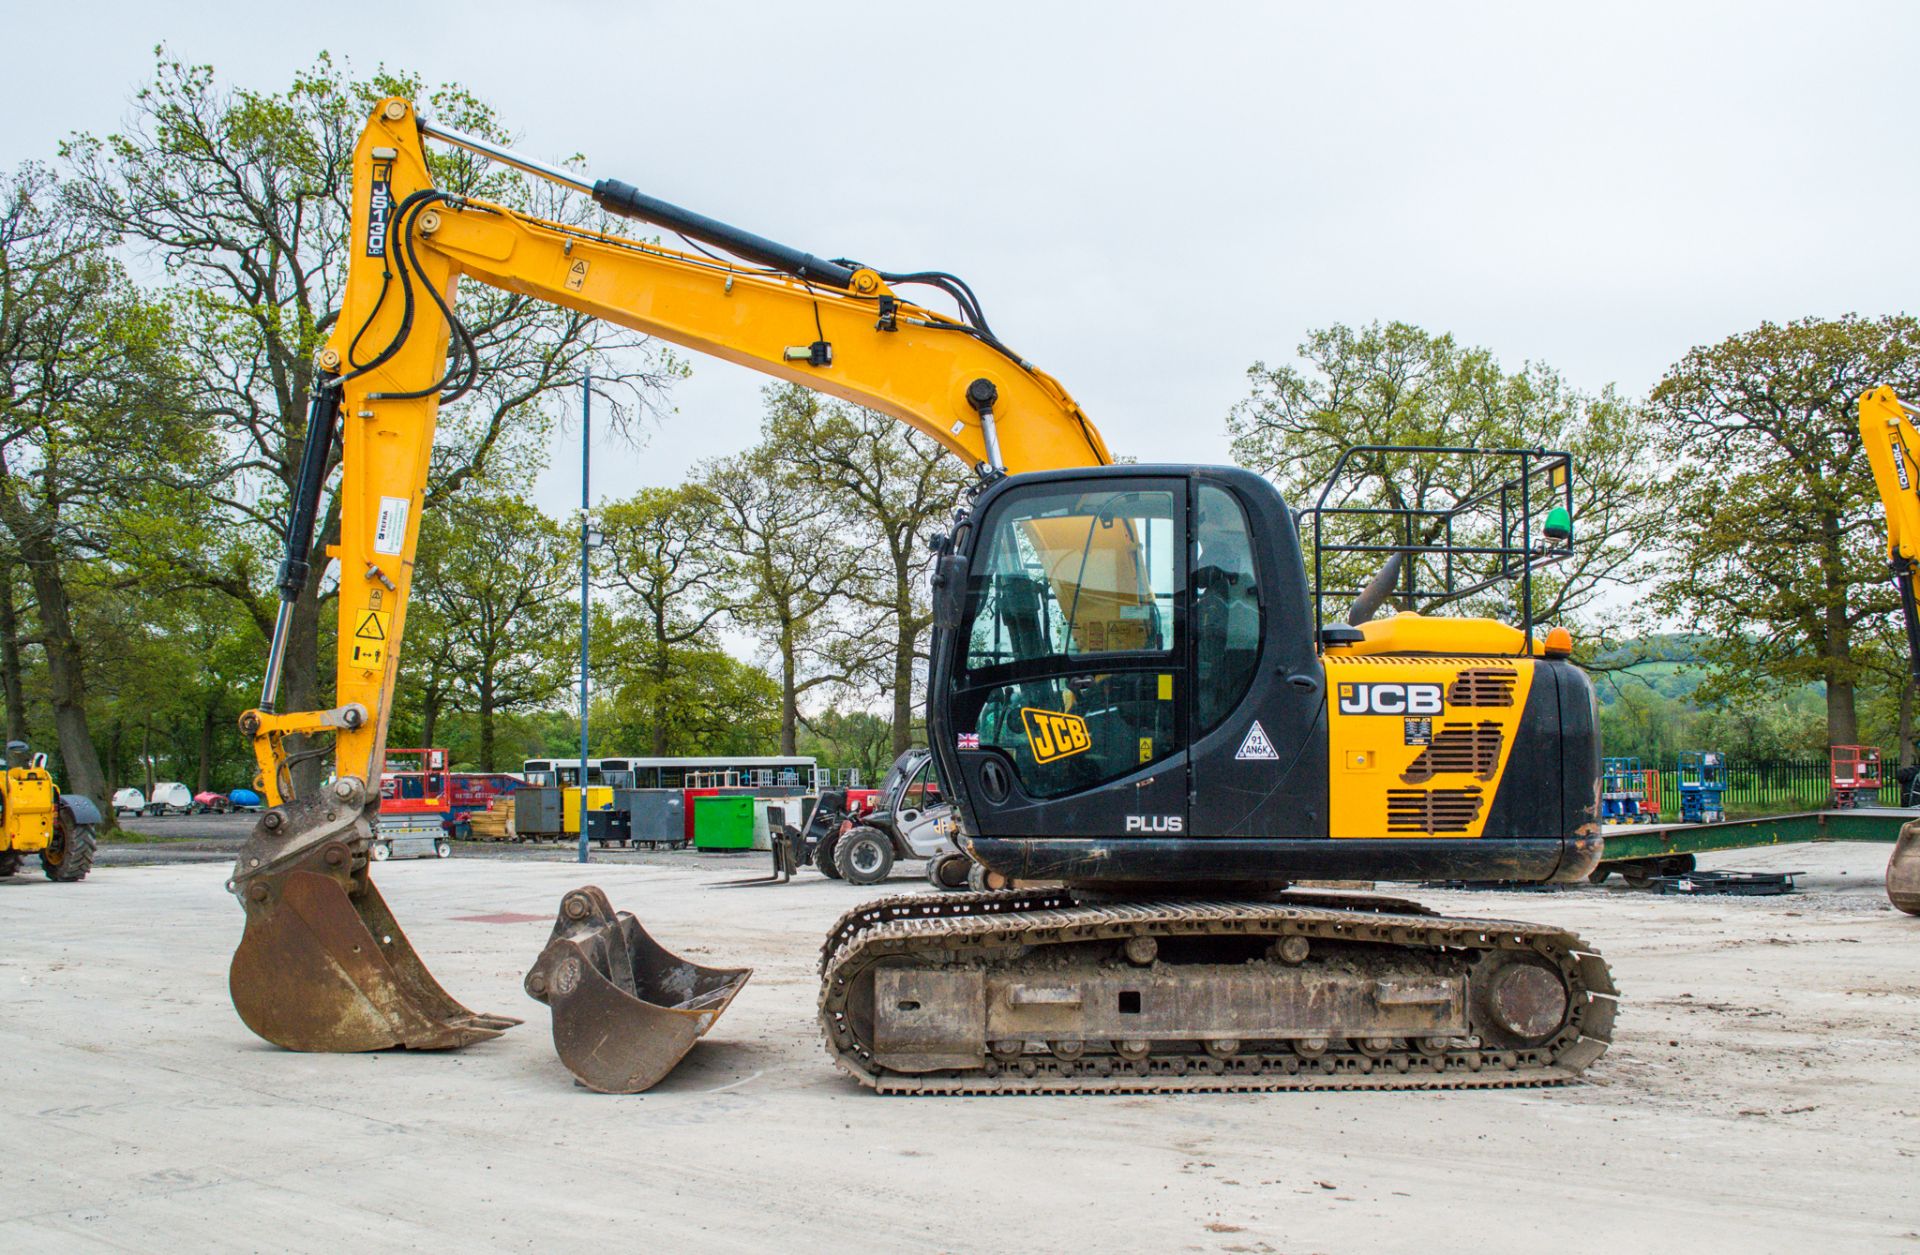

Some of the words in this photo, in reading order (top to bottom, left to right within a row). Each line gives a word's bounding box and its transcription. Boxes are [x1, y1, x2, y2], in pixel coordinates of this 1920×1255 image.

[368, 182, 389, 249] JS130
[1340, 684, 1442, 713] JCB
[1033, 713, 1086, 757] JCB
[1251, 735, 1263, 745] 91
[1126, 815, 1183, 832] PLUS
